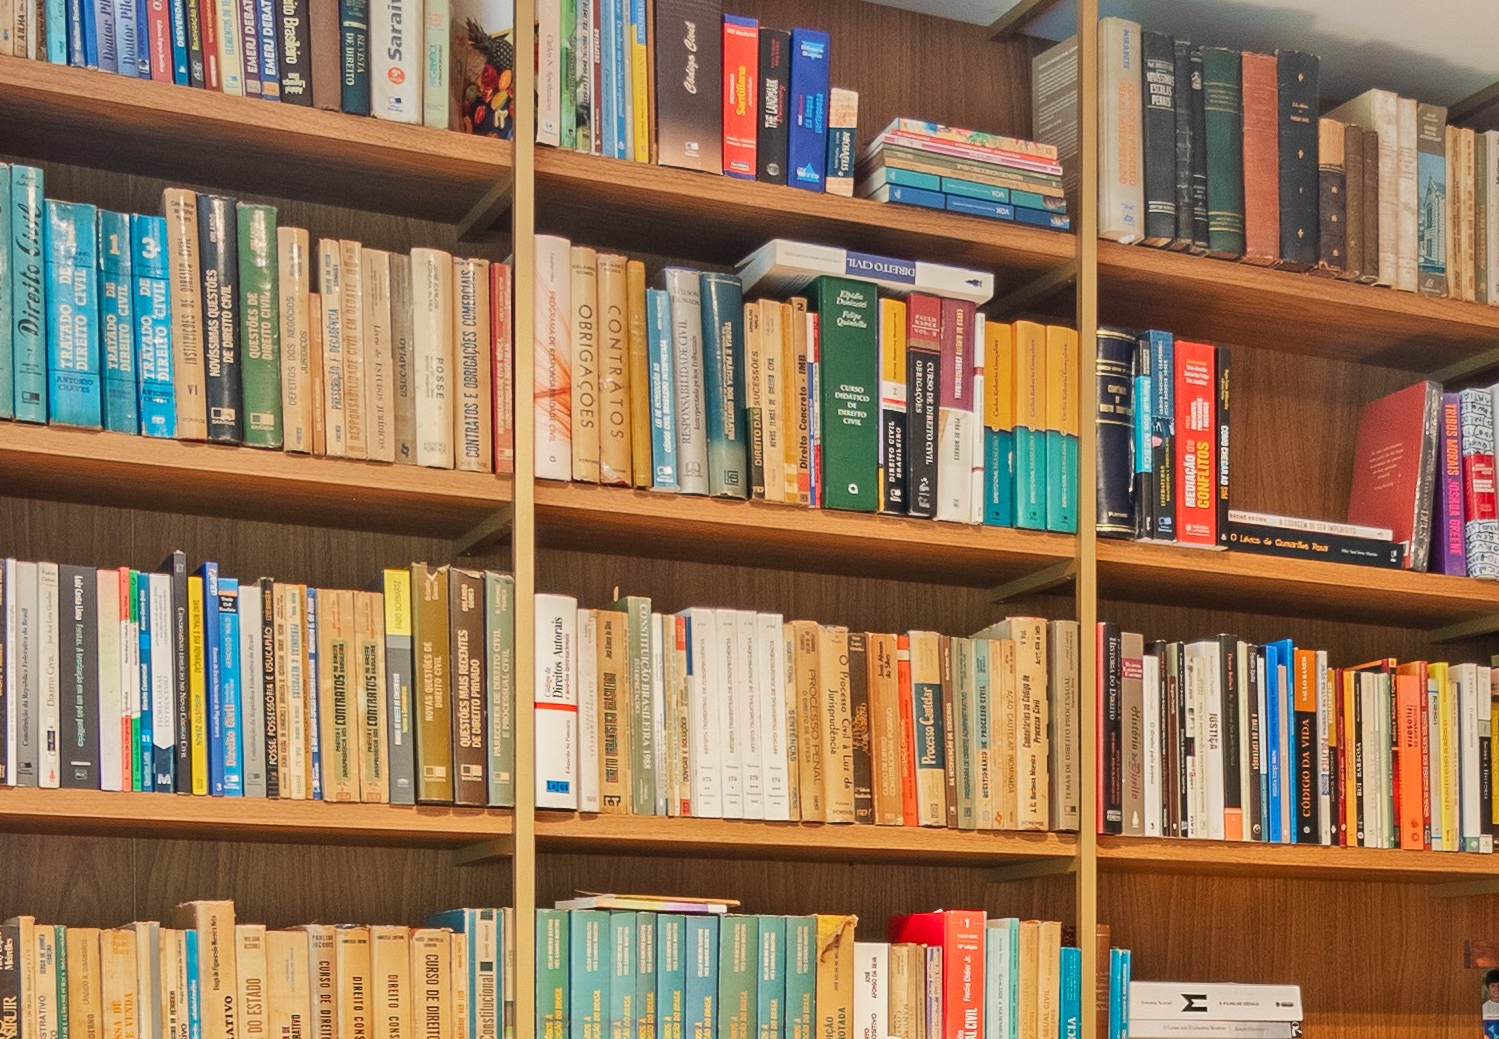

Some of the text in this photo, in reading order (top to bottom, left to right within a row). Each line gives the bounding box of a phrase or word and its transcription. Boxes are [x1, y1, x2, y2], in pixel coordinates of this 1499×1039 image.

[122, 24, 136, 65] Doutor
[244, 37, 258, 73] EMERJ
[684, 21, 699, 94] Código Civil
[736, 65, 746, 115] Santillana
[59, 267, 72, 369] TRATADO DE
[74, 269, 88, 370] DIREITO CIVIL
[206, 269, 220, 376] NOVÍSSIMAS QUESTÕES
[578, 304, 595, 429] OBRIGAÇÕES
[608, 305, 624, 439] CONTRATOS
[1197, 442, 1209, 509] CONFLITOS
[1445, 404, 1461, 555] TRIBOS MORAIS JOSHUA GREENE
[458, 630, 471, 747] QUESTÕES MAIS RECENTES
[551, 617, 564, 698] Direitos Autorais
[919, 687, 936, 764] Processo Cautelar
[1299, 719, 1311, 817] CÓDIGO DA VIDA
